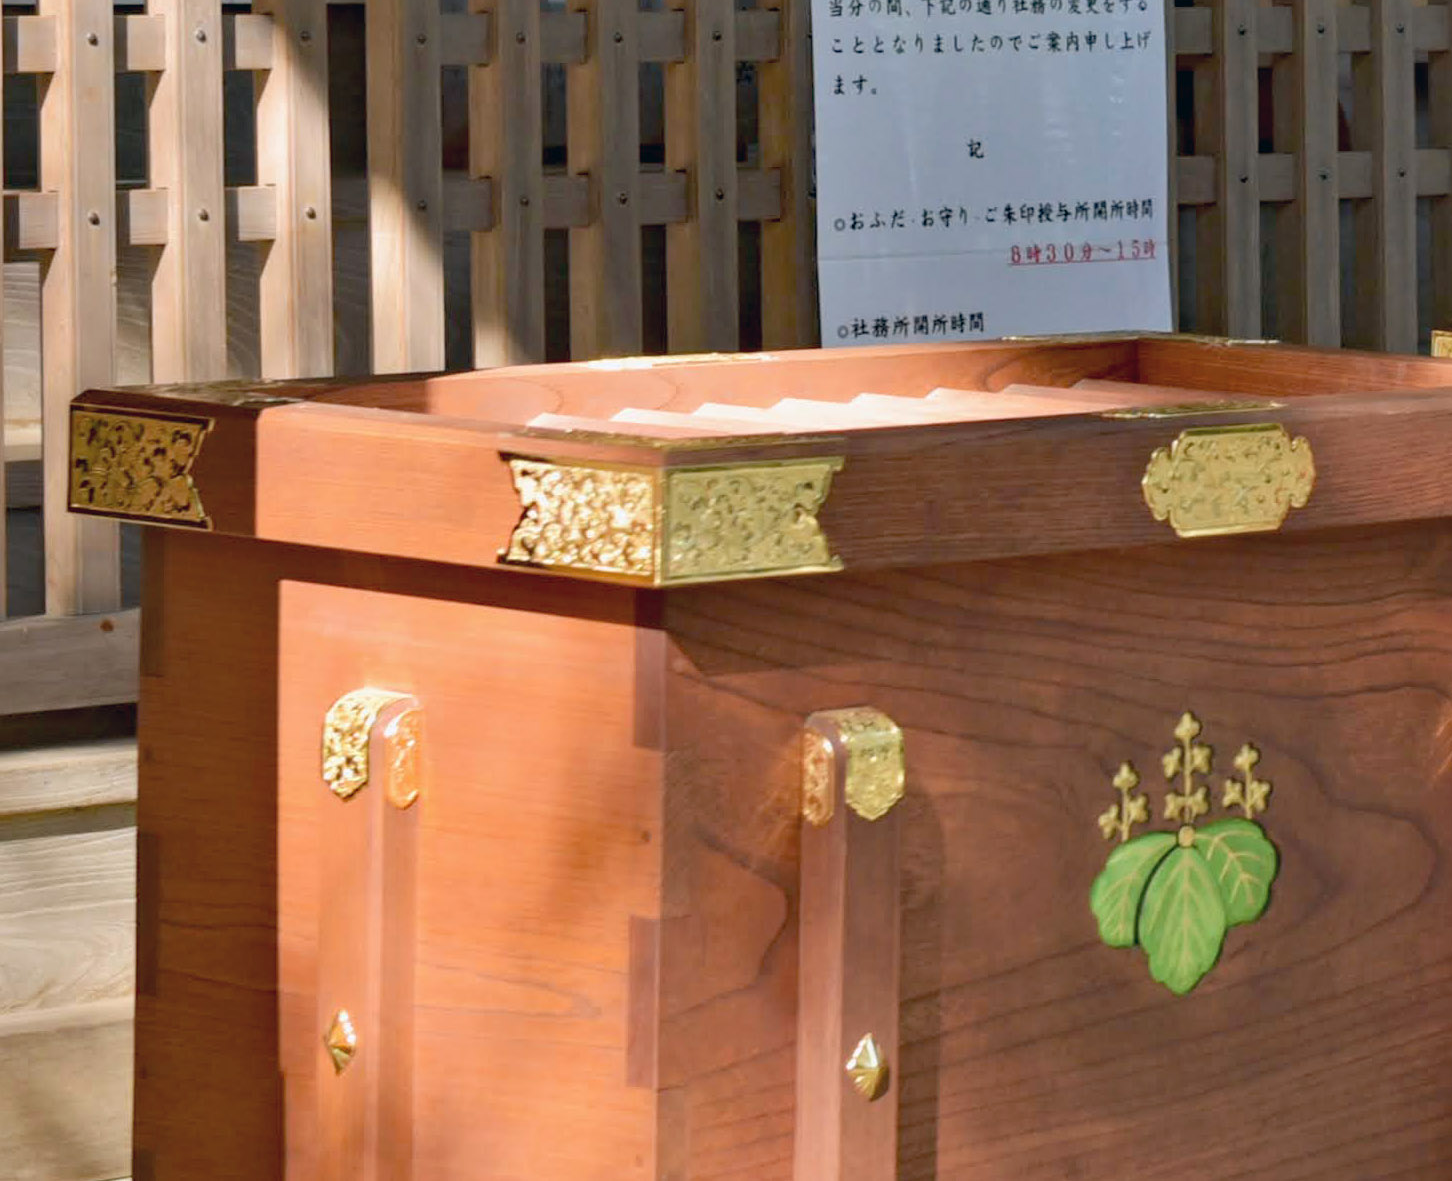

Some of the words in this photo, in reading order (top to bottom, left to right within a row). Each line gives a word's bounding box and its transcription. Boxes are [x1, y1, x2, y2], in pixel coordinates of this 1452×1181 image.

[832, 31, 1152, 54] こととなりましたのでご案内申し上げ
[833, 74, 878, 96] ます。
[967, 139, 985, 159] 記
